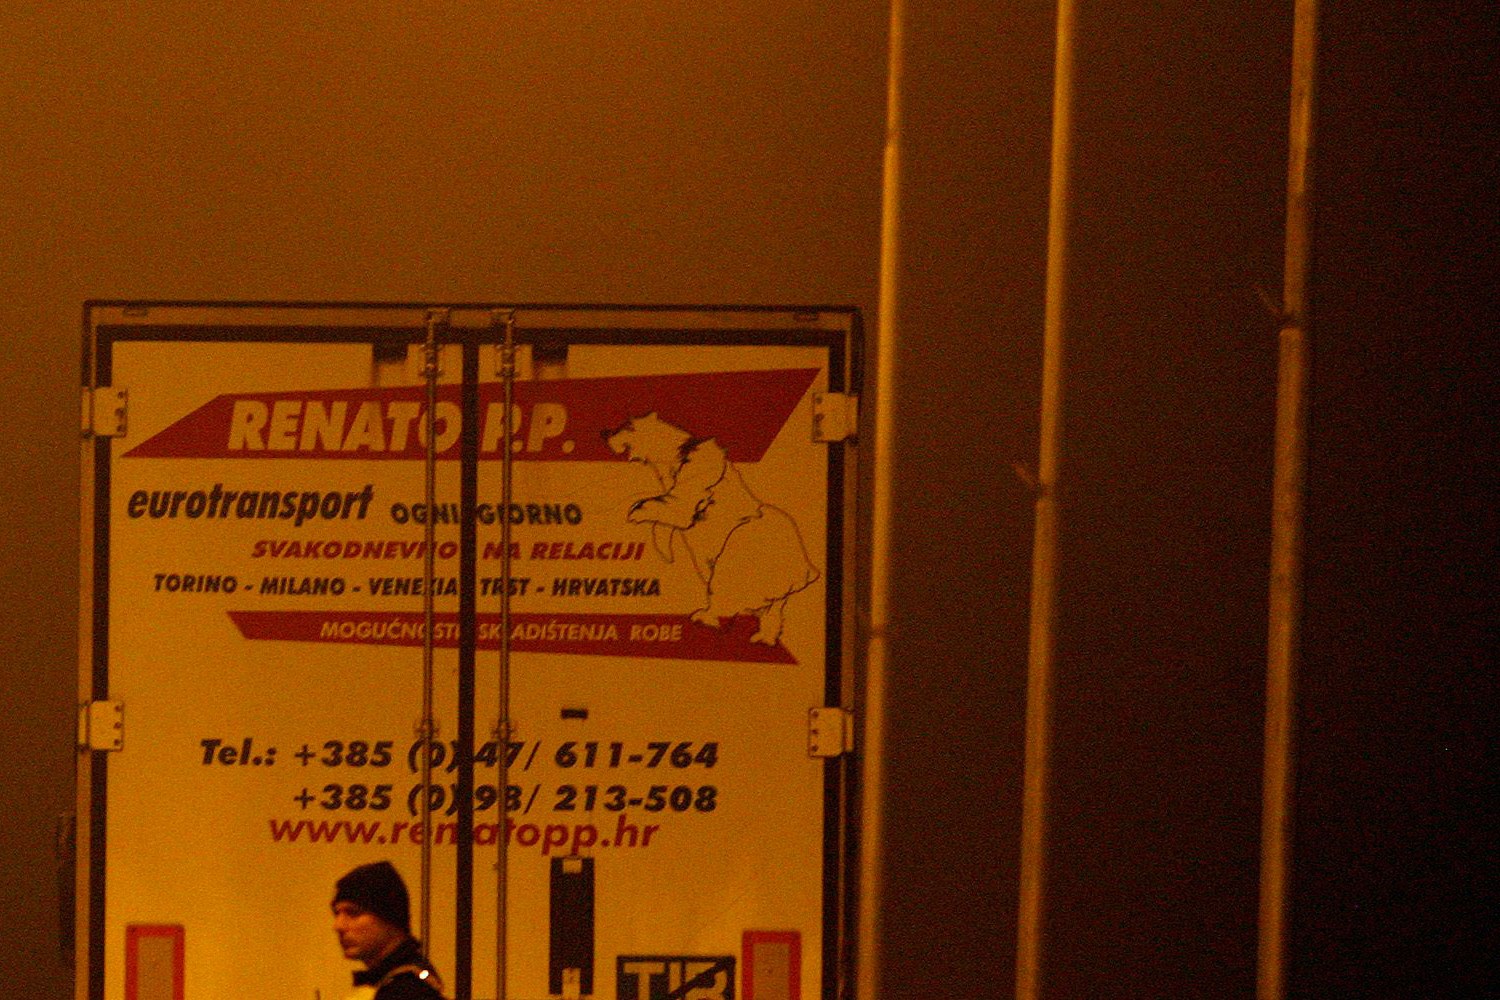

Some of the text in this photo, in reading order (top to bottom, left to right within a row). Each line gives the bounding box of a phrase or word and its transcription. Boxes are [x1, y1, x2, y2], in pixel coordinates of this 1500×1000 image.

[228, 400, 575, 454] RENATO P.P.
[127, 483, 583, 527] eurotransport OGNI GIORNO
[482, 541, 521, 560] NA
[530, 541, 646, 561] RELACIJI
[153, 573, 238, 594] TORINO
[259, 576, 346, 596] MILANO
[552, 577, 661, 597] HRVATSKA
[478, 619, 619, 641] SKADIŠTENJA
[629, 623, 684, 641] ROBE
[199, 738, 277, 767] Tel.:
[293, 739, 395, 768] +385
[554, 740, 719, 768] 611-764
[293, 783, 394, 811] +385
[552, 783, 718, 812] 213-508
[269, 813, 661, 857] www.renatopp.hr
